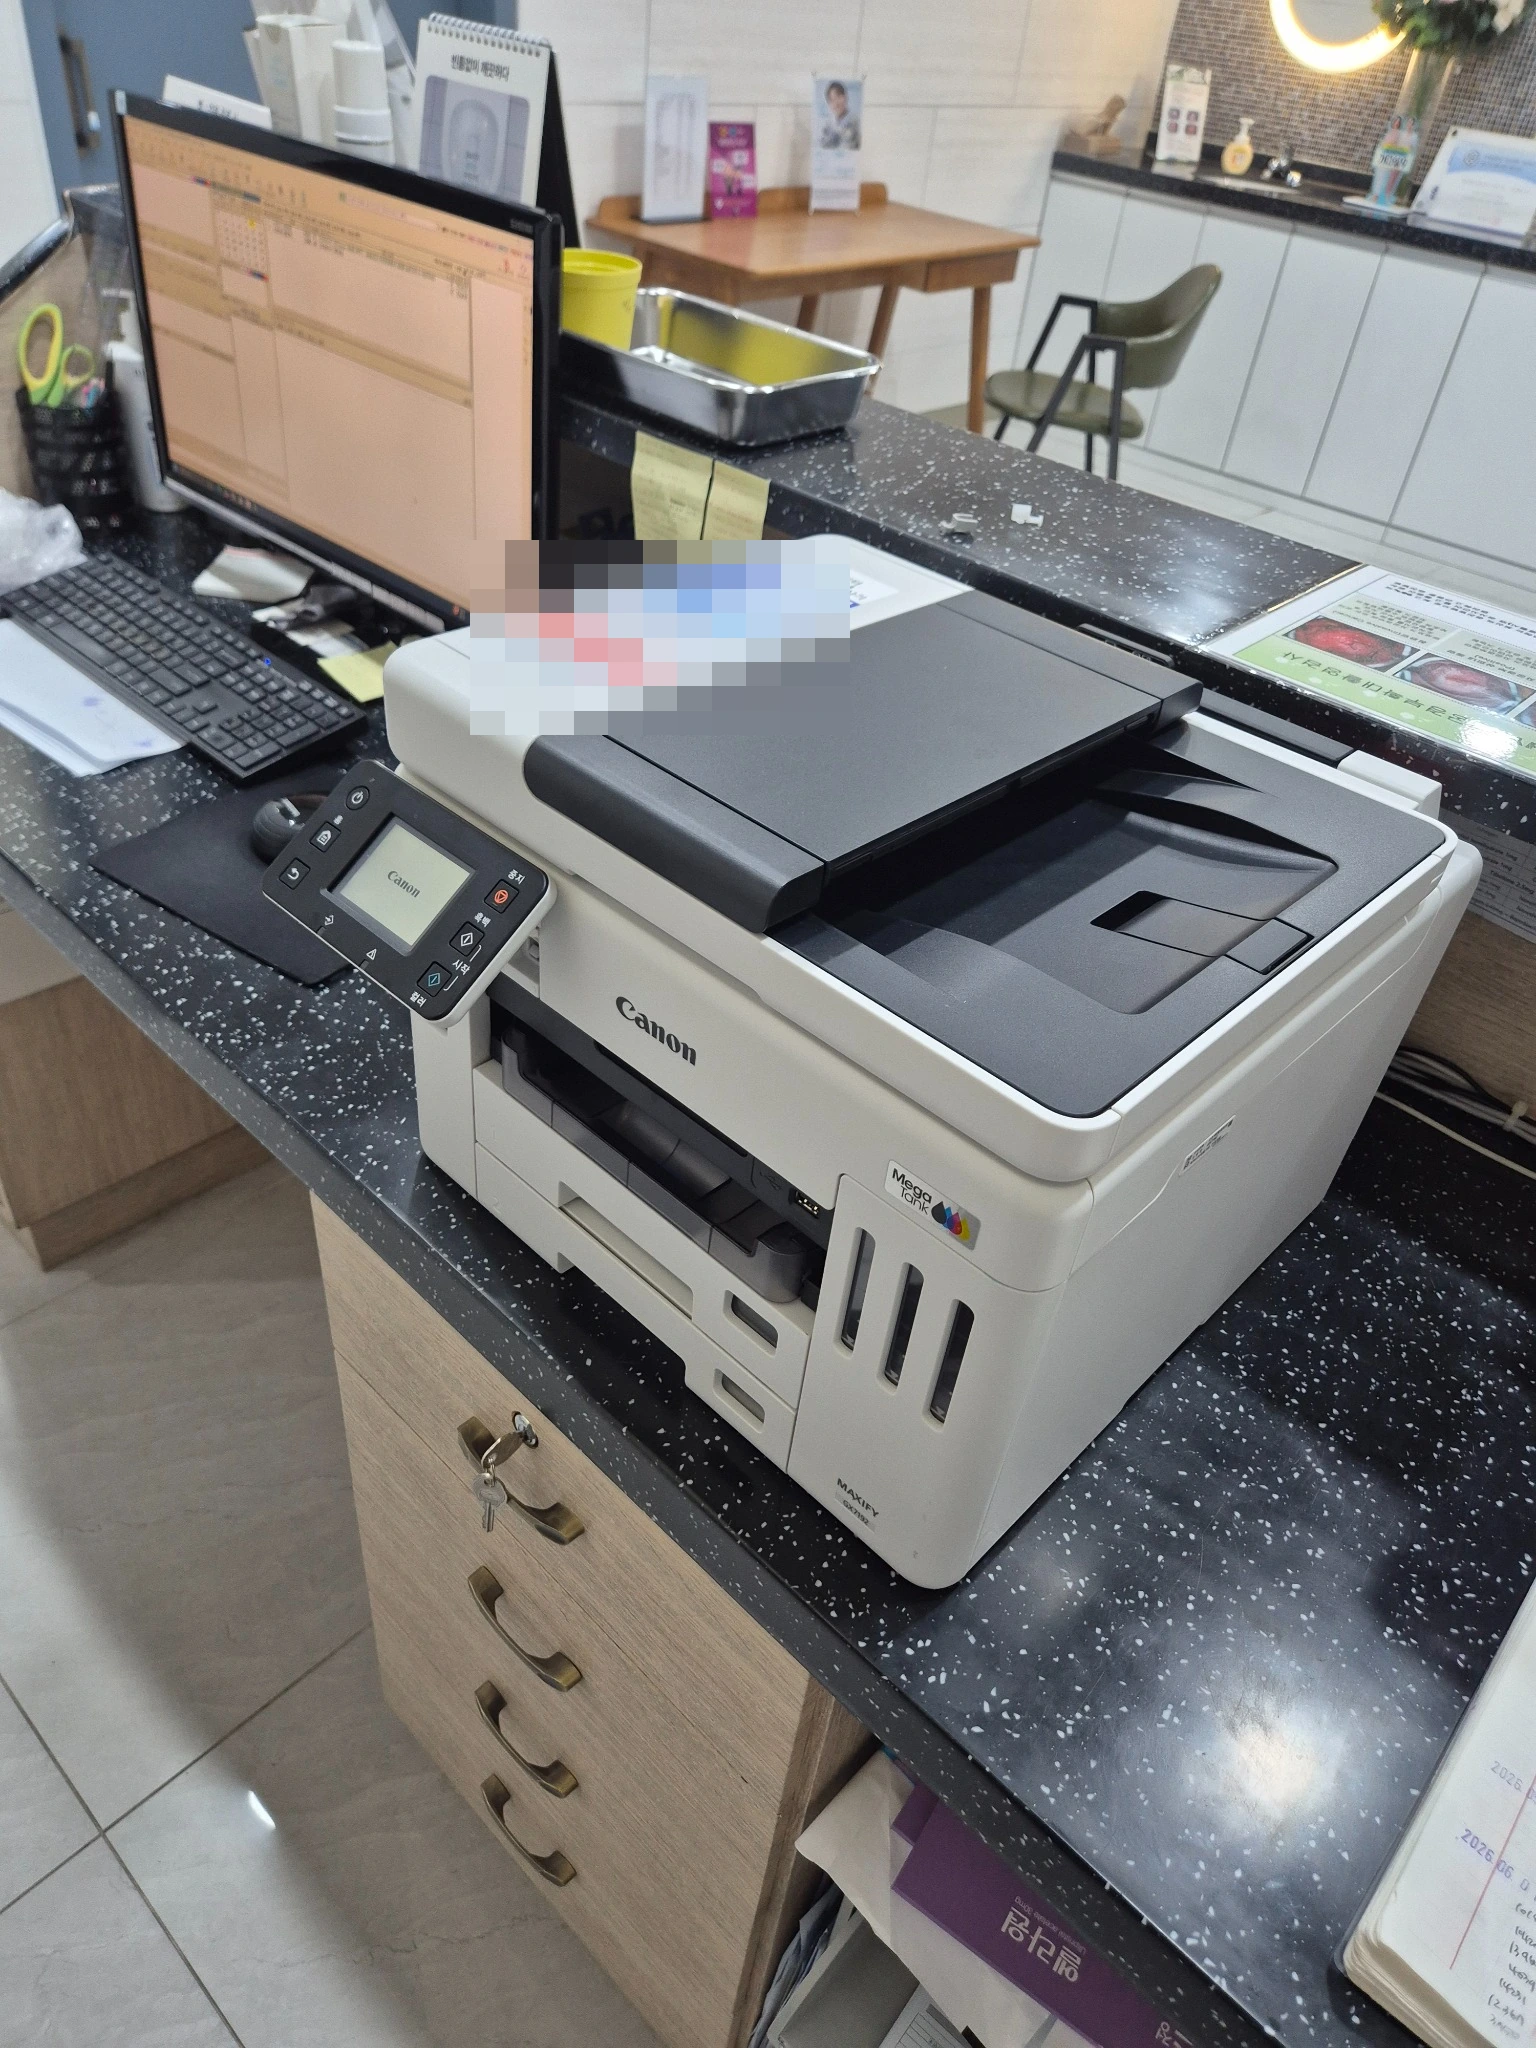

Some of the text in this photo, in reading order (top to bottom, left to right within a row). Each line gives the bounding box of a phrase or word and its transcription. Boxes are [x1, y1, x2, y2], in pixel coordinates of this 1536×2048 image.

[388, 870, 420, 898] Canon
[507, 869, 526, 885] 중지
[474, 912, 491, 928] 흑백
[452, 959, 471, 976] 시작
[409, 991, 427, 1008] 컬러
[615, 996, 697, 1066] Canon
[892, 1168, 933, 1204] Mega
[900, 1185, 930, 1215] Tank
[837, 1478, 879, 1517] MAXIFY
[1001, 1906, 1082, 1982] 엘라원
